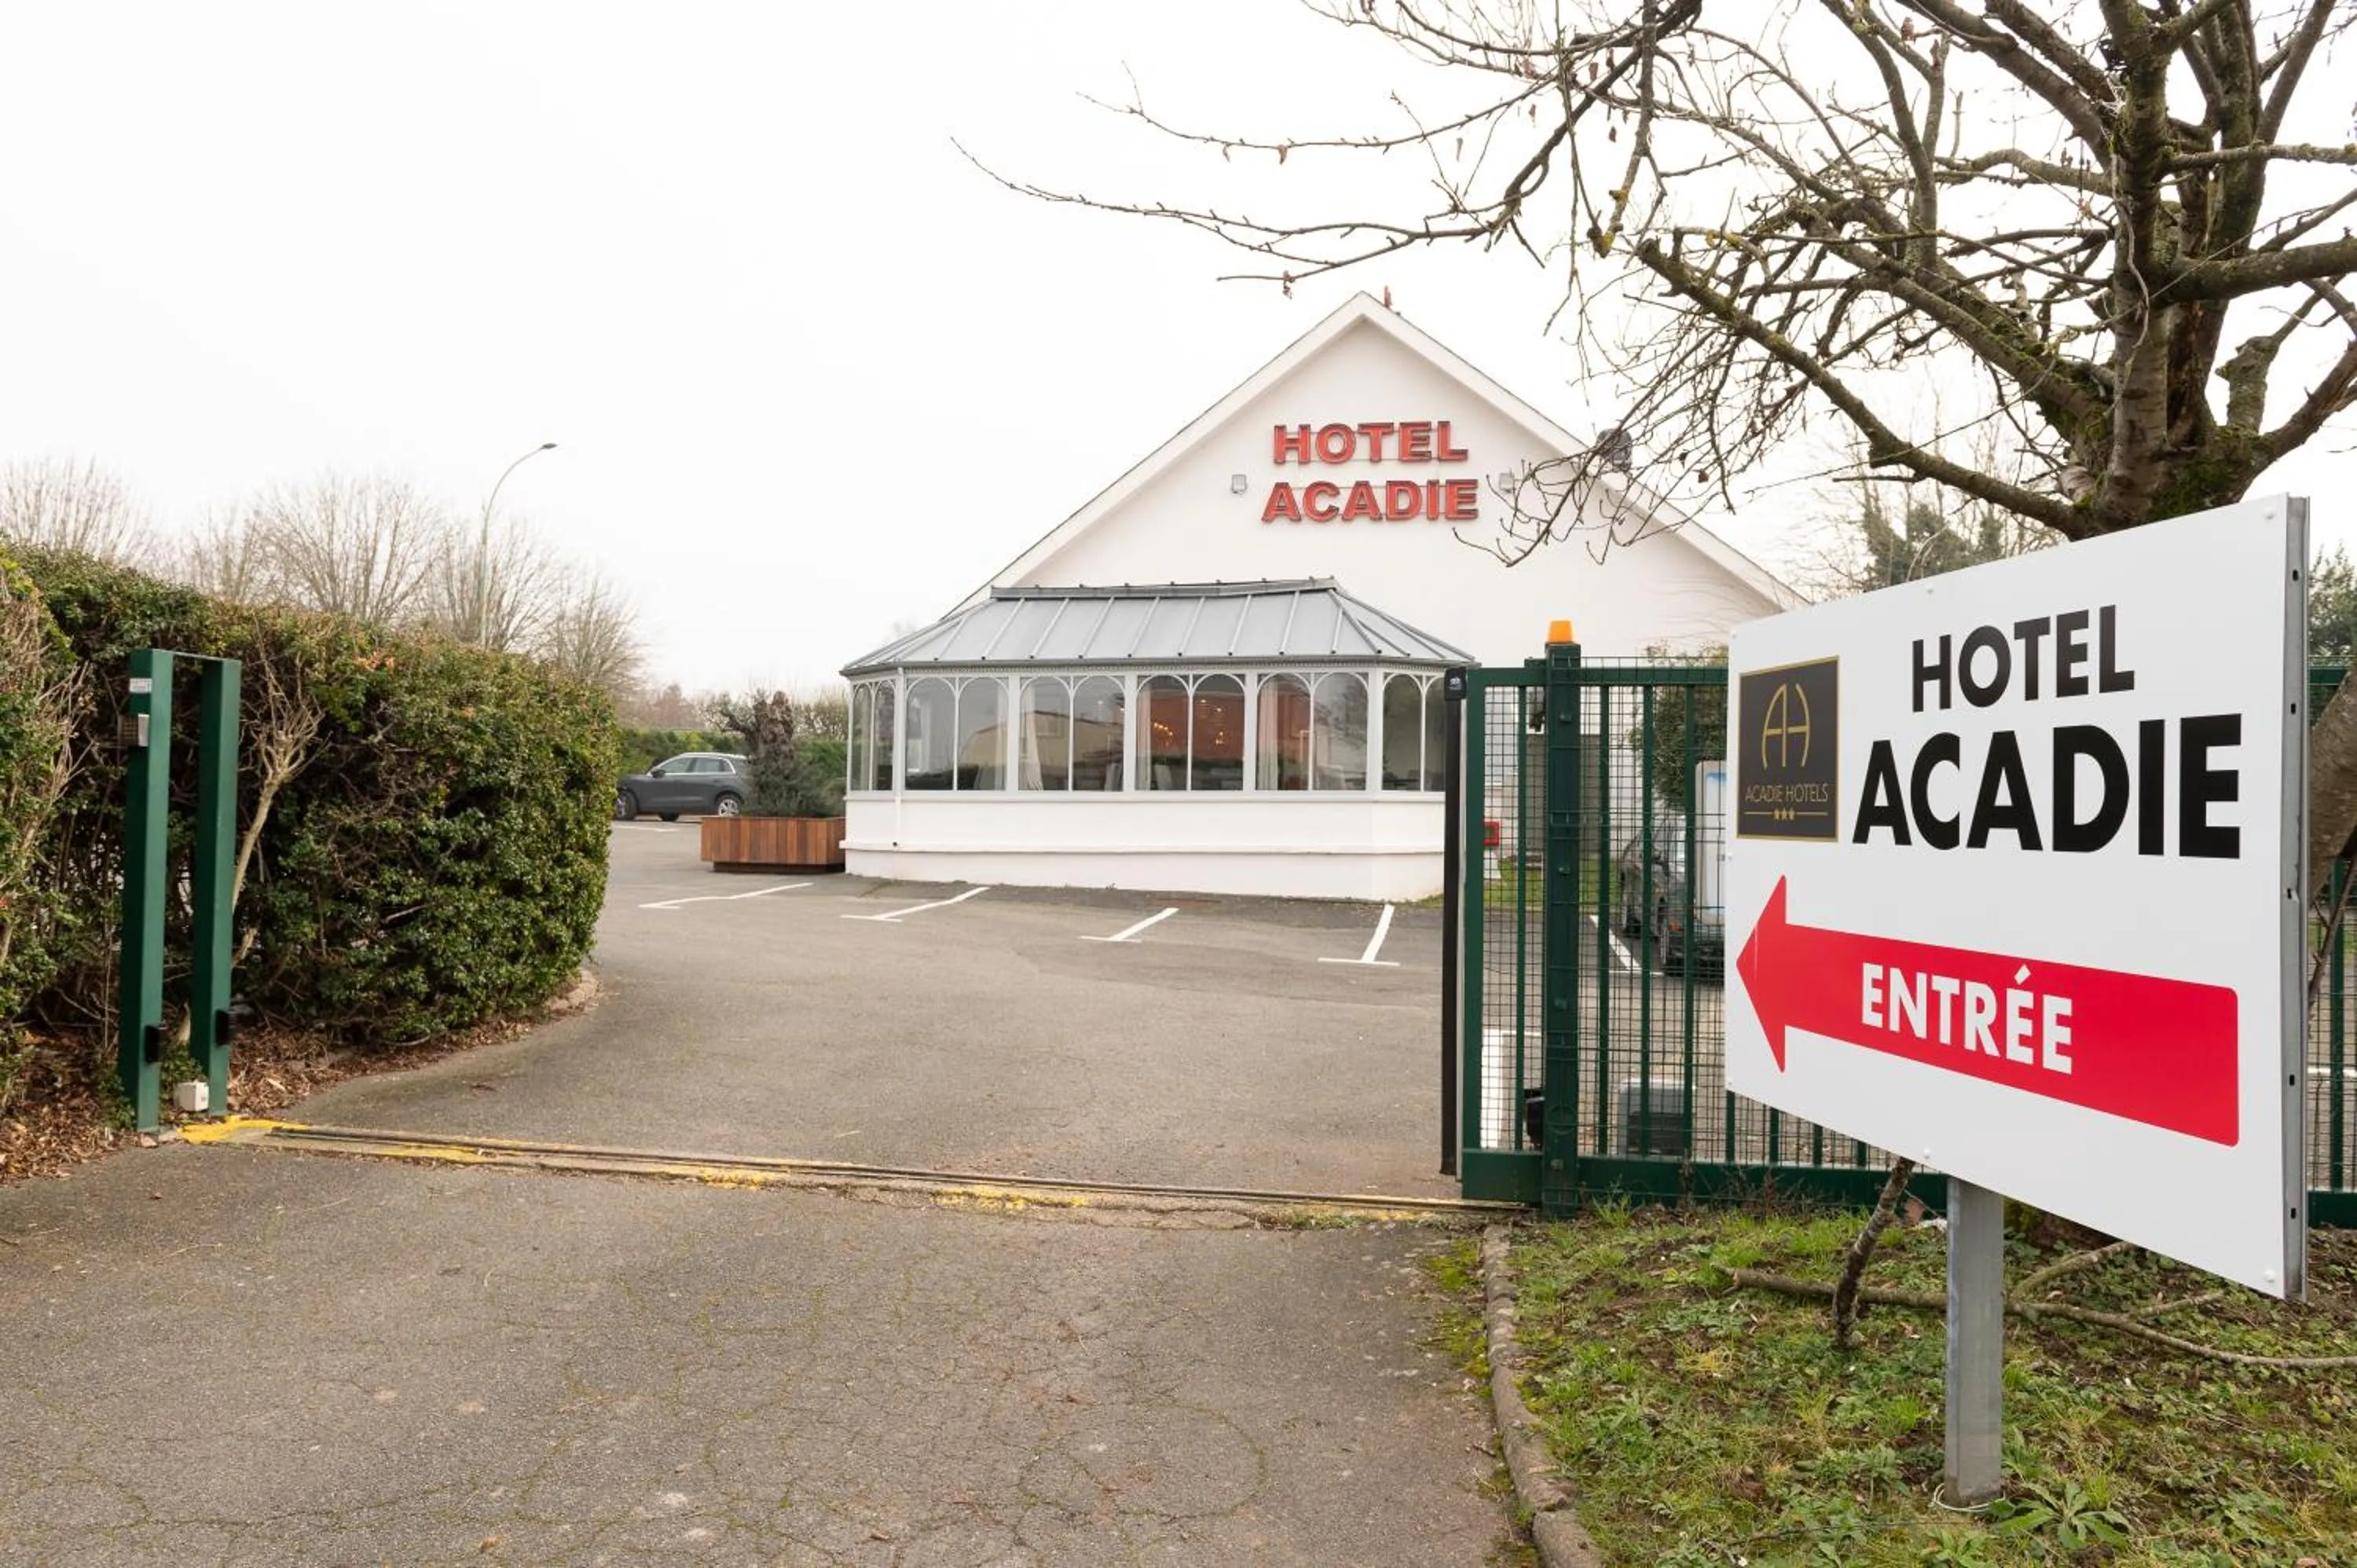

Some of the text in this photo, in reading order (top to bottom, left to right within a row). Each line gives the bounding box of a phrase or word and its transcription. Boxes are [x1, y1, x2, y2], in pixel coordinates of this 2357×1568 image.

[1273, 420, 1468, 463] HOTEL
[1262, 478, 1479, 522] ACADIE
[1912, 604, 2135, 713] HOTEL
[1744, 783, 1829, 802] ACADIE HOTELS
[1852, 713, 2242, 859] ACADIE
[1861, 963, 2073, 1075] ENTRÉE
